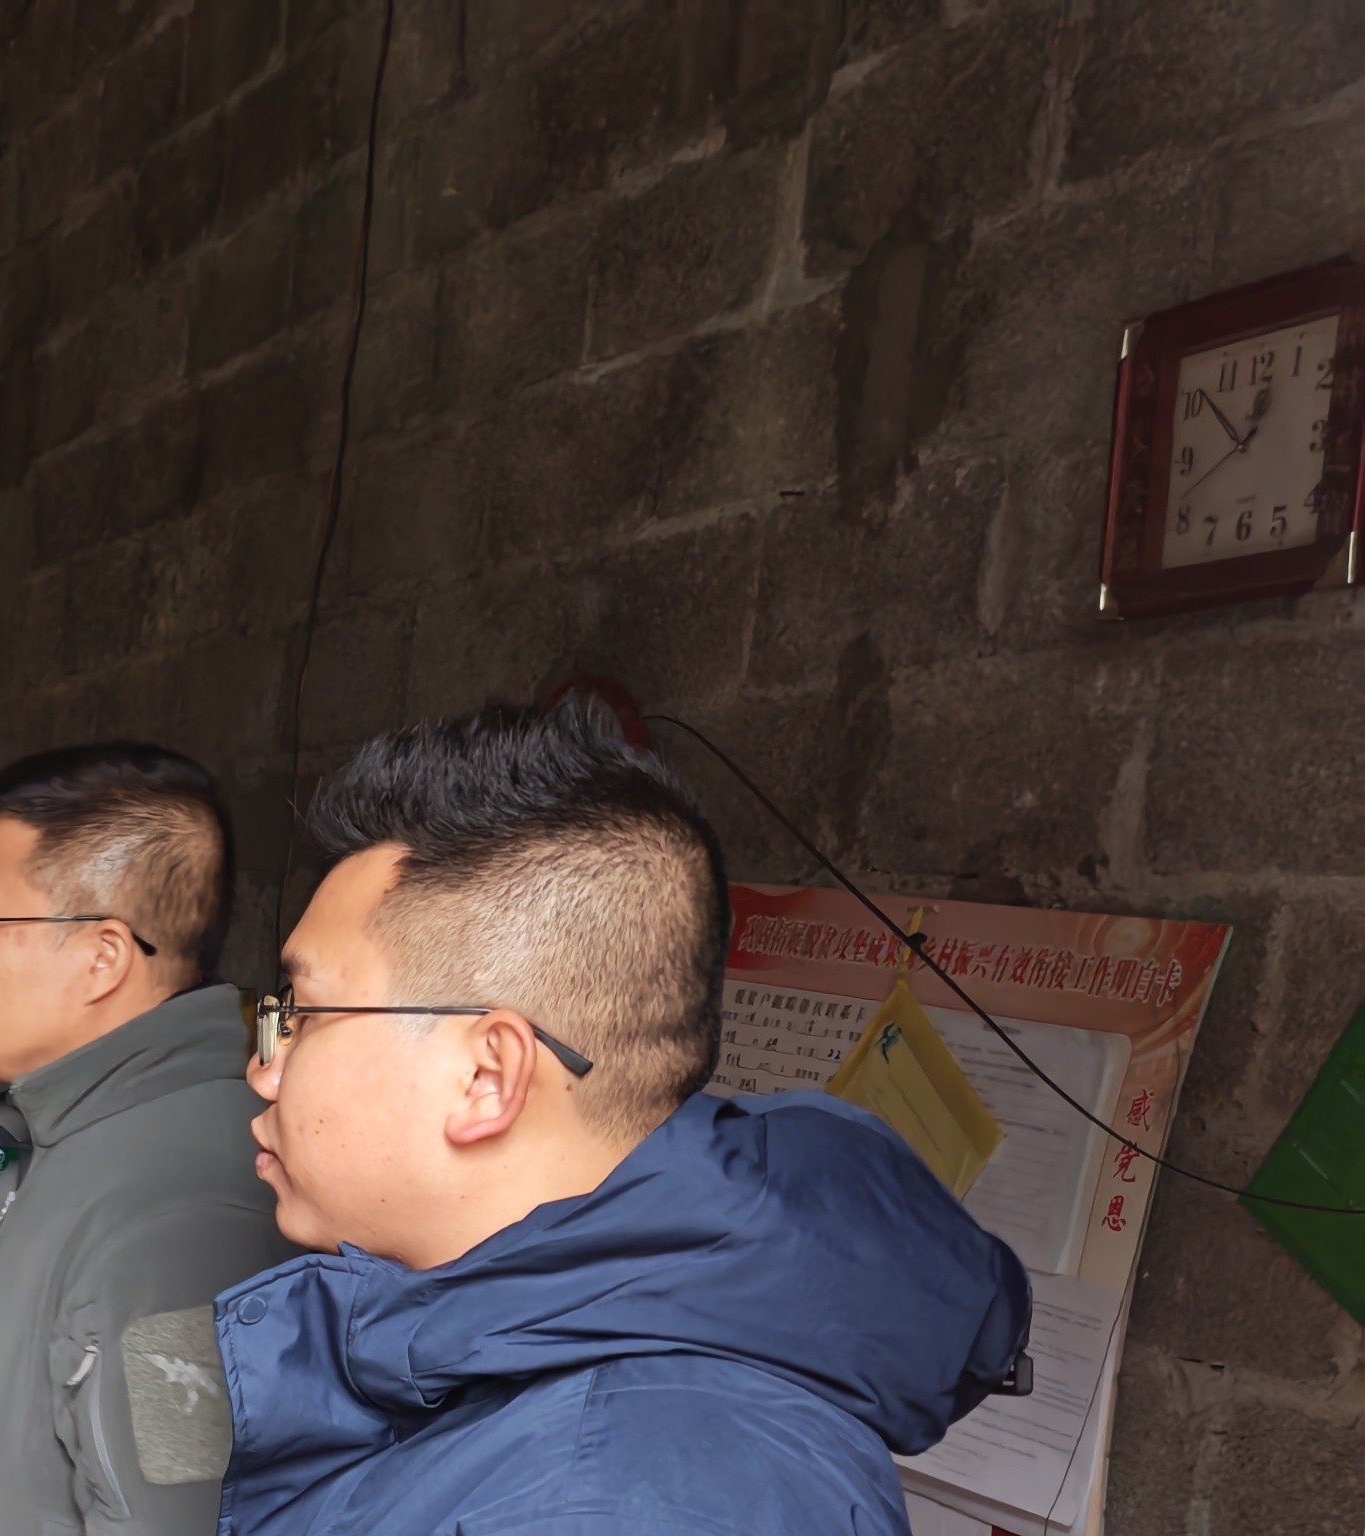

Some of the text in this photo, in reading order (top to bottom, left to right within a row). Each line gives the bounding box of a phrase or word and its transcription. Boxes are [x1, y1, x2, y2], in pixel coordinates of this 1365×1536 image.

[1218, 359, 1238, 393] 11
[1249, 351, 1275, 386] 12
[1291, 346, 1302, 377] 1
[1315, 358, 1334, 391] 2
[1181, 389, 1203, 423] 10
[1309, 419, 1329, 453] 3
[1180, 446, 1194, 476] 9
[1203, 515, 1219, 547] 7
[1235, 510, 1253, 542] 6
[1269, 504, 1287, 537] 5
[1101, 1088, 1155, 1232] 感党恩
